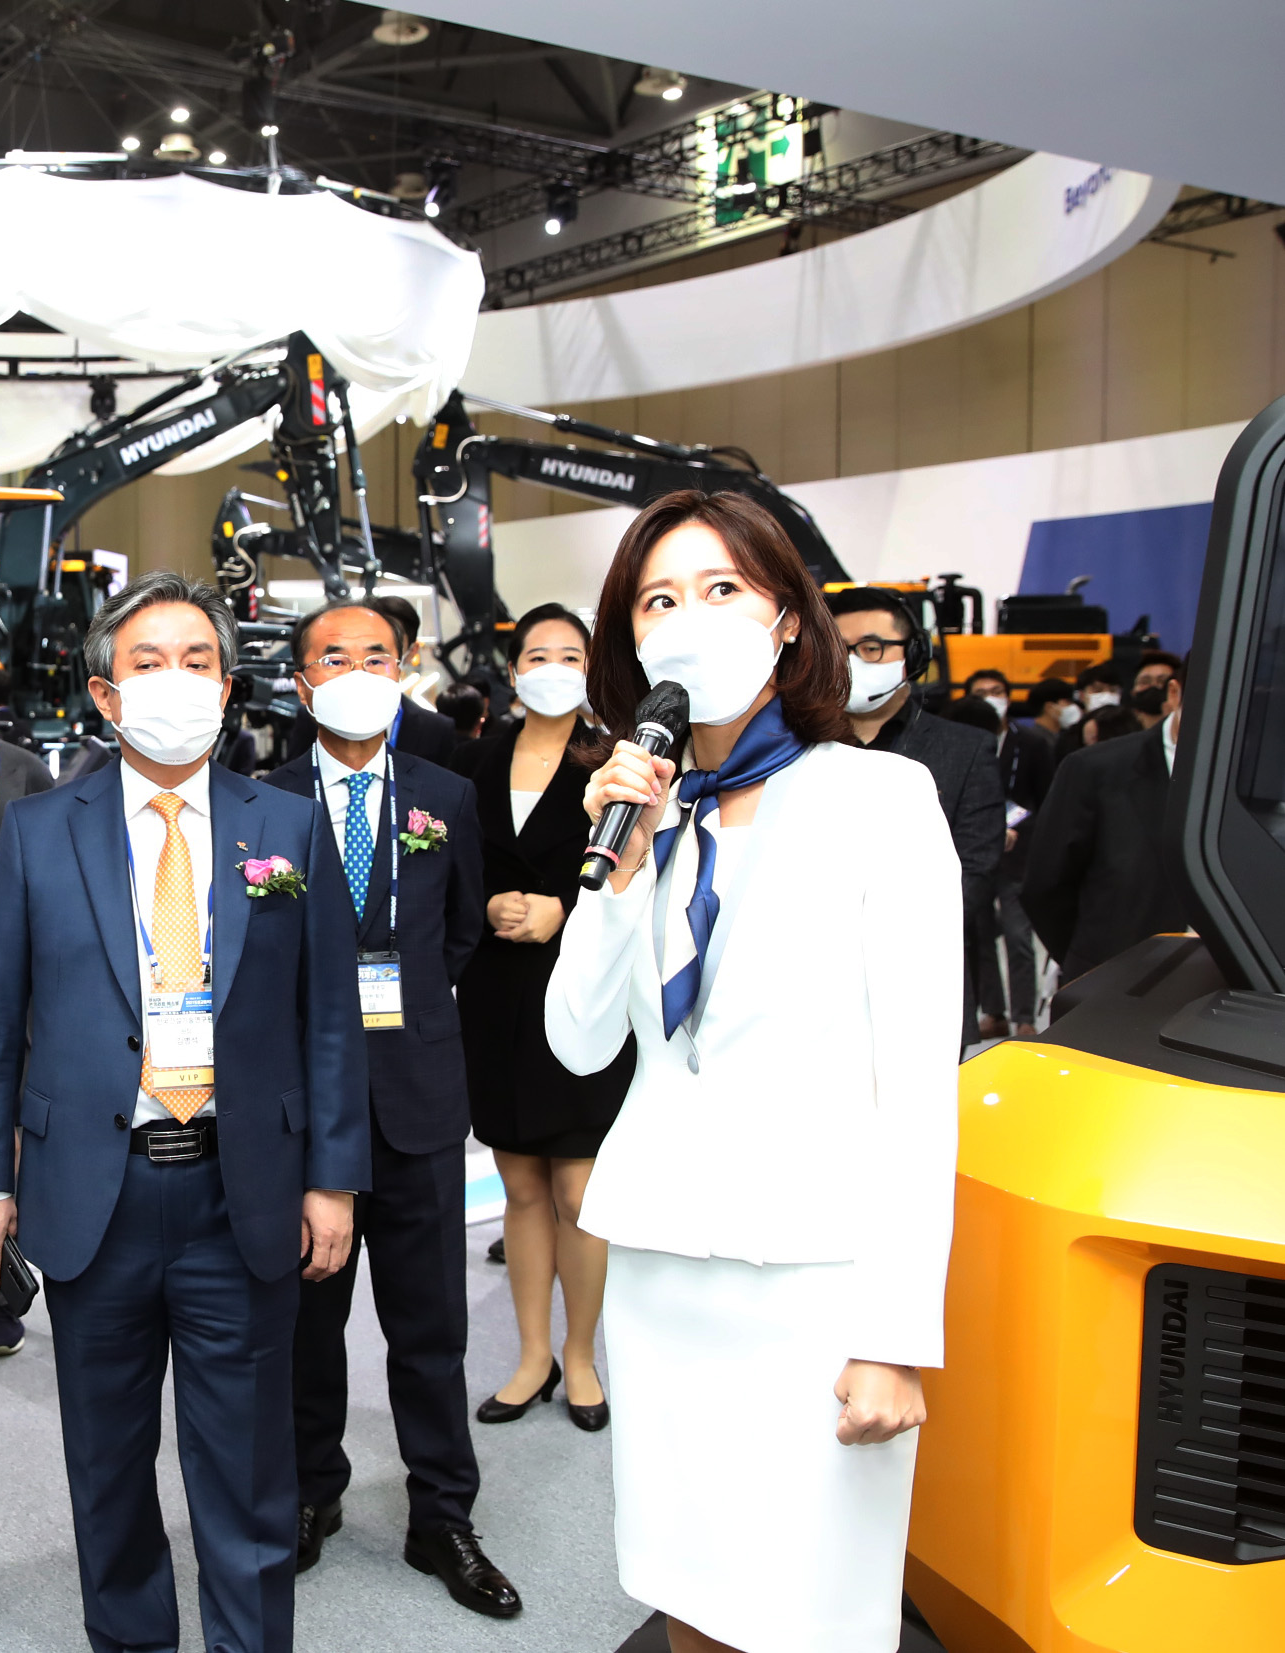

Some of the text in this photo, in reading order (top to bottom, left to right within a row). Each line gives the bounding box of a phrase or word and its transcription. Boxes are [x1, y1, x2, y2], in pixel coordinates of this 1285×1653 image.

[119, 407, 217, 466] HYUNDAI
[540, 457, 635, 491] HYUNDAI
[179, 1073, 199, 1082] VIP
[1157, 1278, 1189, 1425] HYUNDAI
